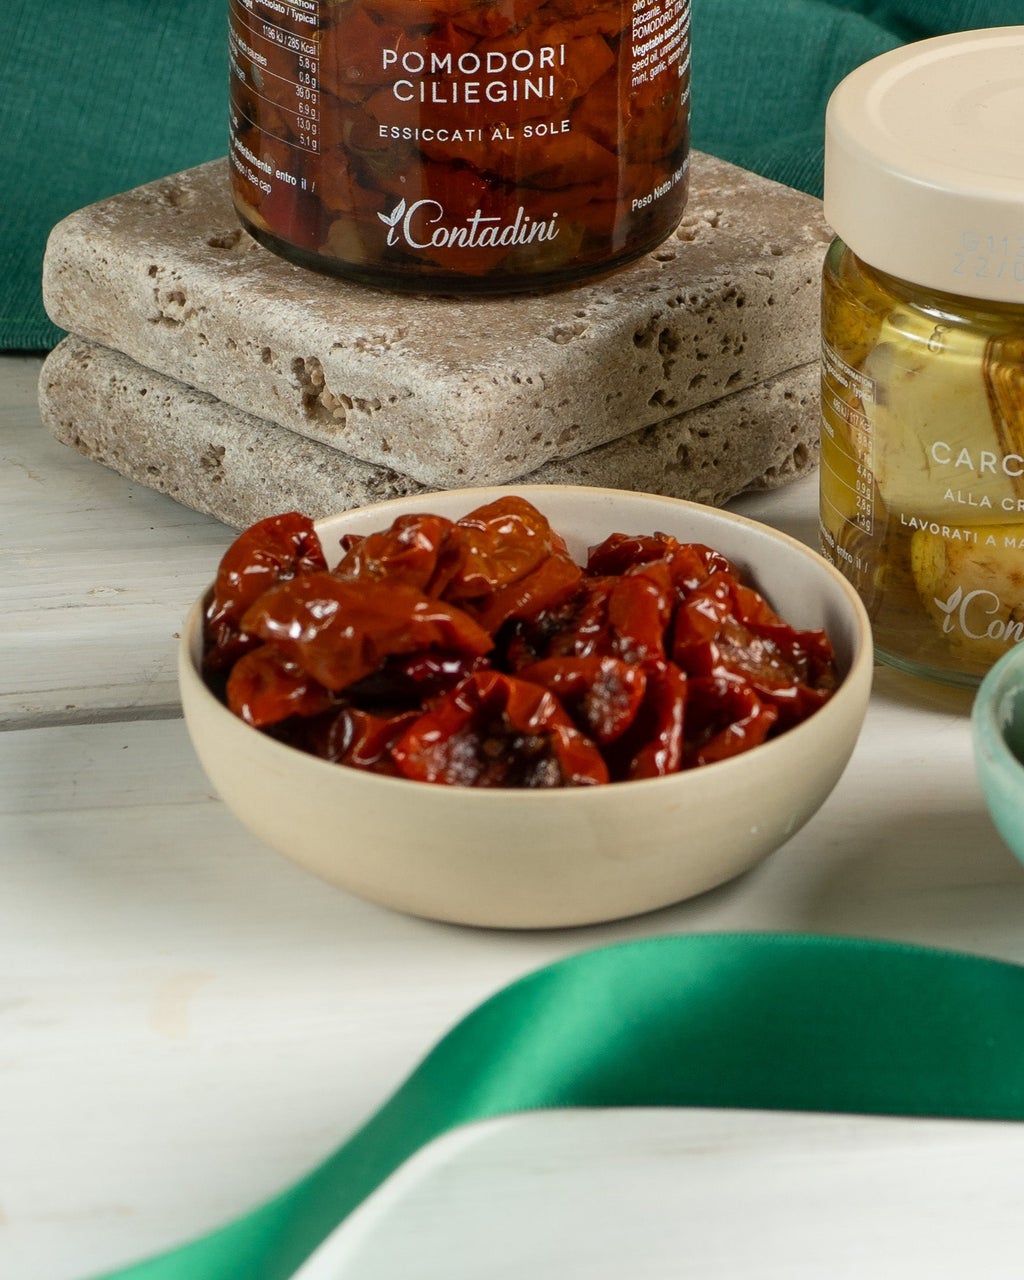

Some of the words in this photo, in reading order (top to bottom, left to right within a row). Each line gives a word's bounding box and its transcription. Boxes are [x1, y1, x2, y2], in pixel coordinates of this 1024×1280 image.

[291, 8, 317, 25] Typical
[632, 0, 645, 12] olio
[288, 35, 299, 50] 285
[301, 40, 316, 55] Kcal
[632, 33, 664, 58] Vegetable
[382, 44, 565, 74] POMODORI
[632, 56, 649, 72] seed
[393, 75, 554, 103] CILIEGINI
[379, 124, 482, 141] ESSICCATI
[491, 128, 514, 141] AL
[523, 120, 570, 138] SOLE
[259, 181, 272, 195] cap
[275, 169, 297, 185] entro
[301, 177, 307, 190] il
[632, 193, 652, 212] Peso
[654, 181, 671, 201] Netto
[944, 488, 992, 508] ALLA
[901, 513, 978, 543] LAVORATI
[985, 535, 997, 546] A
